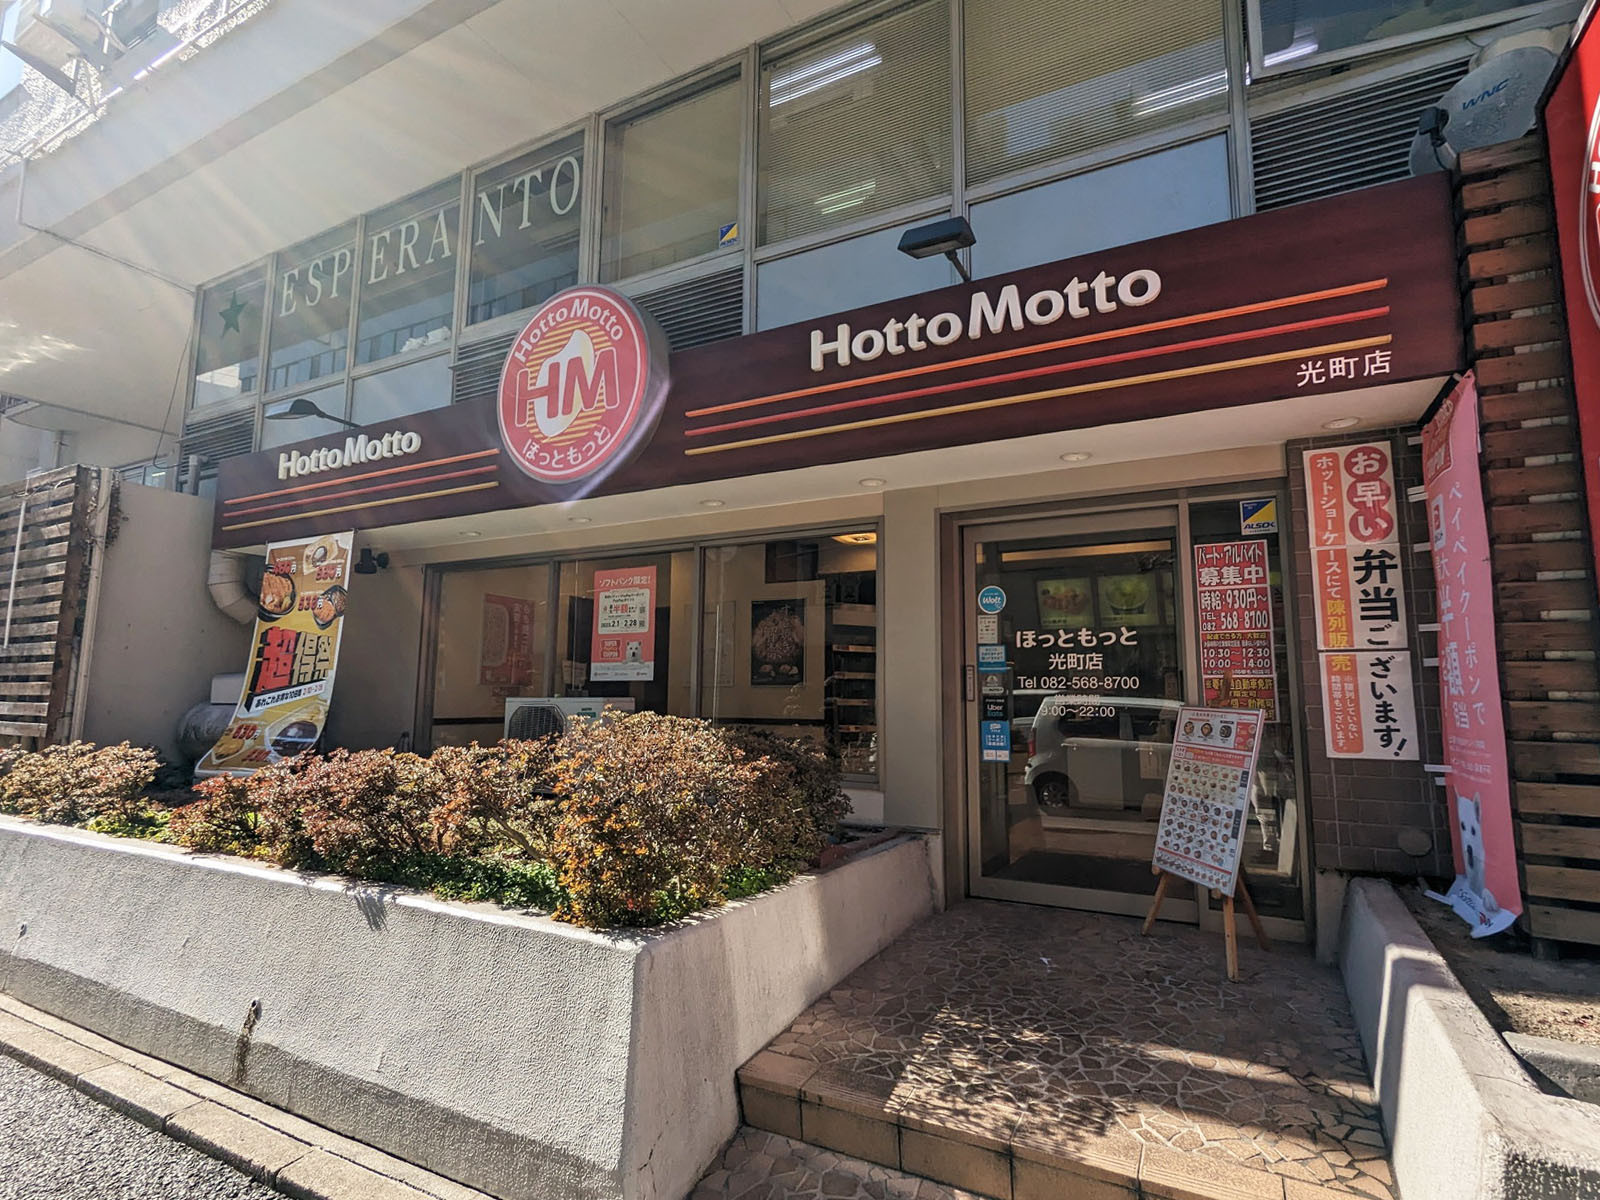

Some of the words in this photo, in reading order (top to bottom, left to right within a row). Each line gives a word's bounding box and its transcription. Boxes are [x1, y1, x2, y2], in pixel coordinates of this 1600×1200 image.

[1462, 78, 1509, 111] WNC
[279, 156, 580, 318] ESPERANTO
[514, 298, 623, 363] HottoMotto
[810, 268, 1162, 372] HottoMotto
[1296, 350, 1392, 388] 光町店
[278, 430, 421, 480] HottoMotto
[522, 426, 611, 468] ほっともっと
[1199, 564, 1264, 586] 募集中
[1202, 612, 1216, 620] TEL
[1202, 622, 1216, 631] 082
[1220, 610, 1268, 630] 568-8700
[1015, 626, 1138, 648] ほっともっと
[1048, 652, 1104, 670] 光町店
[1018, 676, 1036, 689] Tel
[1040, 676, 1140, 689] 082-568-8700
